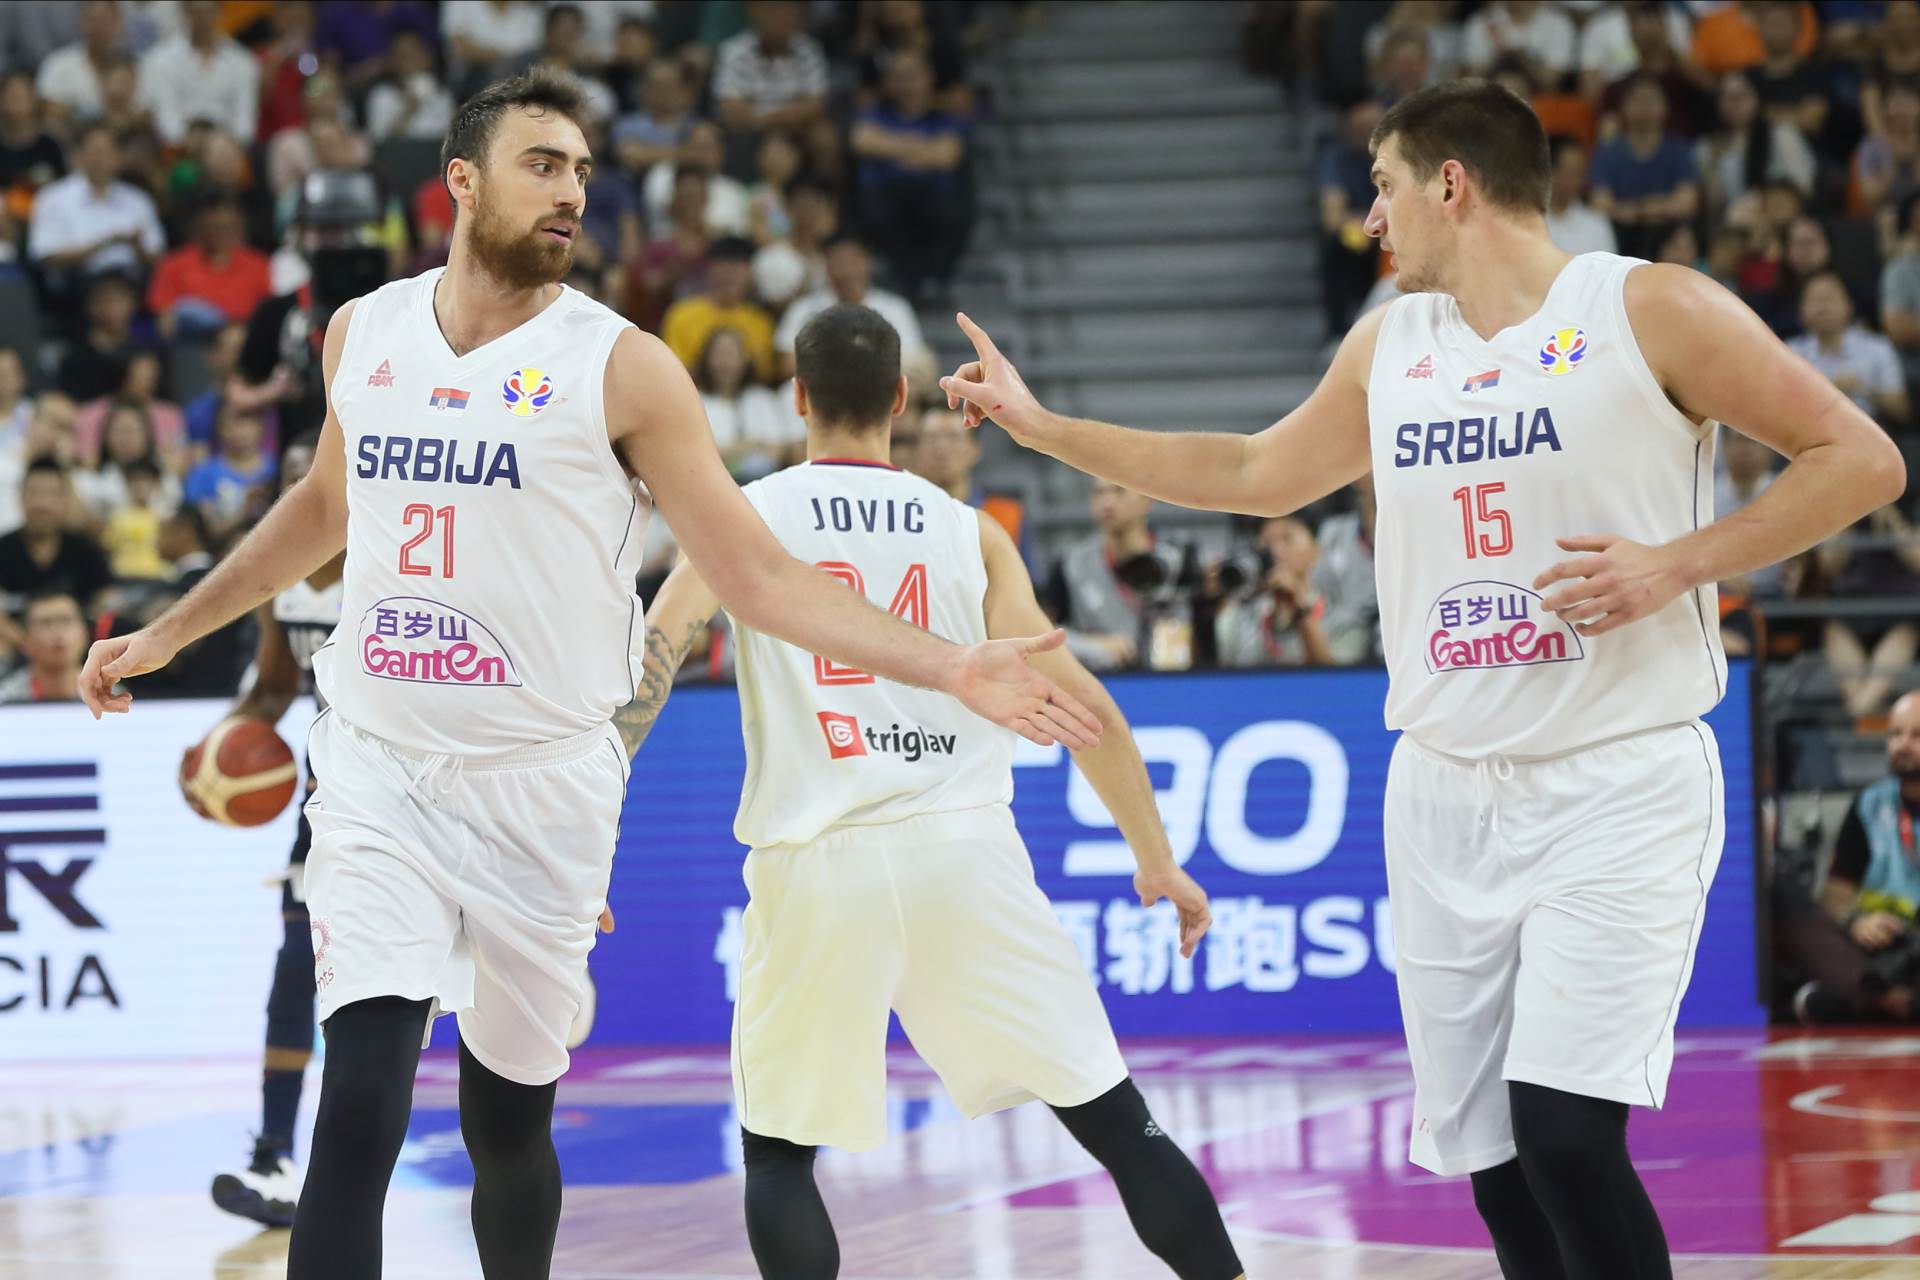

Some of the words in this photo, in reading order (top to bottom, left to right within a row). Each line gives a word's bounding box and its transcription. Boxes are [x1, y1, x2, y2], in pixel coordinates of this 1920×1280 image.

[1395, 407, 1562, 468] SRBIJA
[356, 435, 522, 489] SRBIJA
[810, 496, 925, 533] JOVIĆ
[1453, 482, 1514, 560] 15
[399, 503, 456, 578] 21
[375, 608, 468, 641] 百岁山
[1439, 594, 1528, 628] 百岁山
[865, 723, 956, 762] triglav
